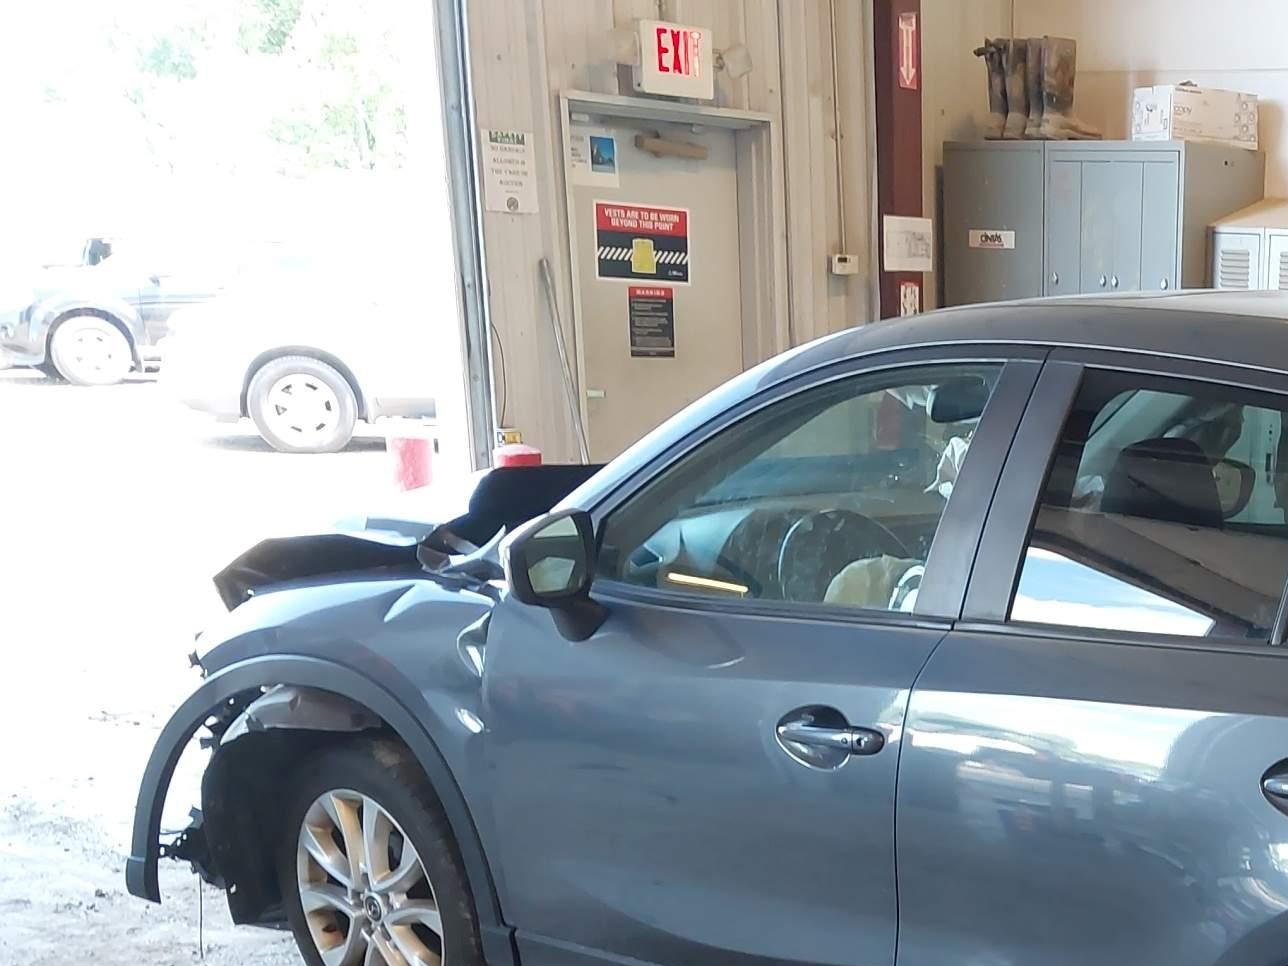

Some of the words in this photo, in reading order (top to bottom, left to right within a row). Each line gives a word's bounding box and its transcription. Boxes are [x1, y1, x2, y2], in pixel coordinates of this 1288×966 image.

[656, 28, 702, 77] EXIT
[604, 208, 625, 217] VESTS
[626, 210, 639, 219] ARE
[641, 211, 649, 219] TO
[650, 212, 658, 220] BE
[659, 213, 679, 222] WORN
[611, 218, 638, 228] BEYOND
[639, 220, 653, 229] THIS
[654, 221, 673, 231] POINT
